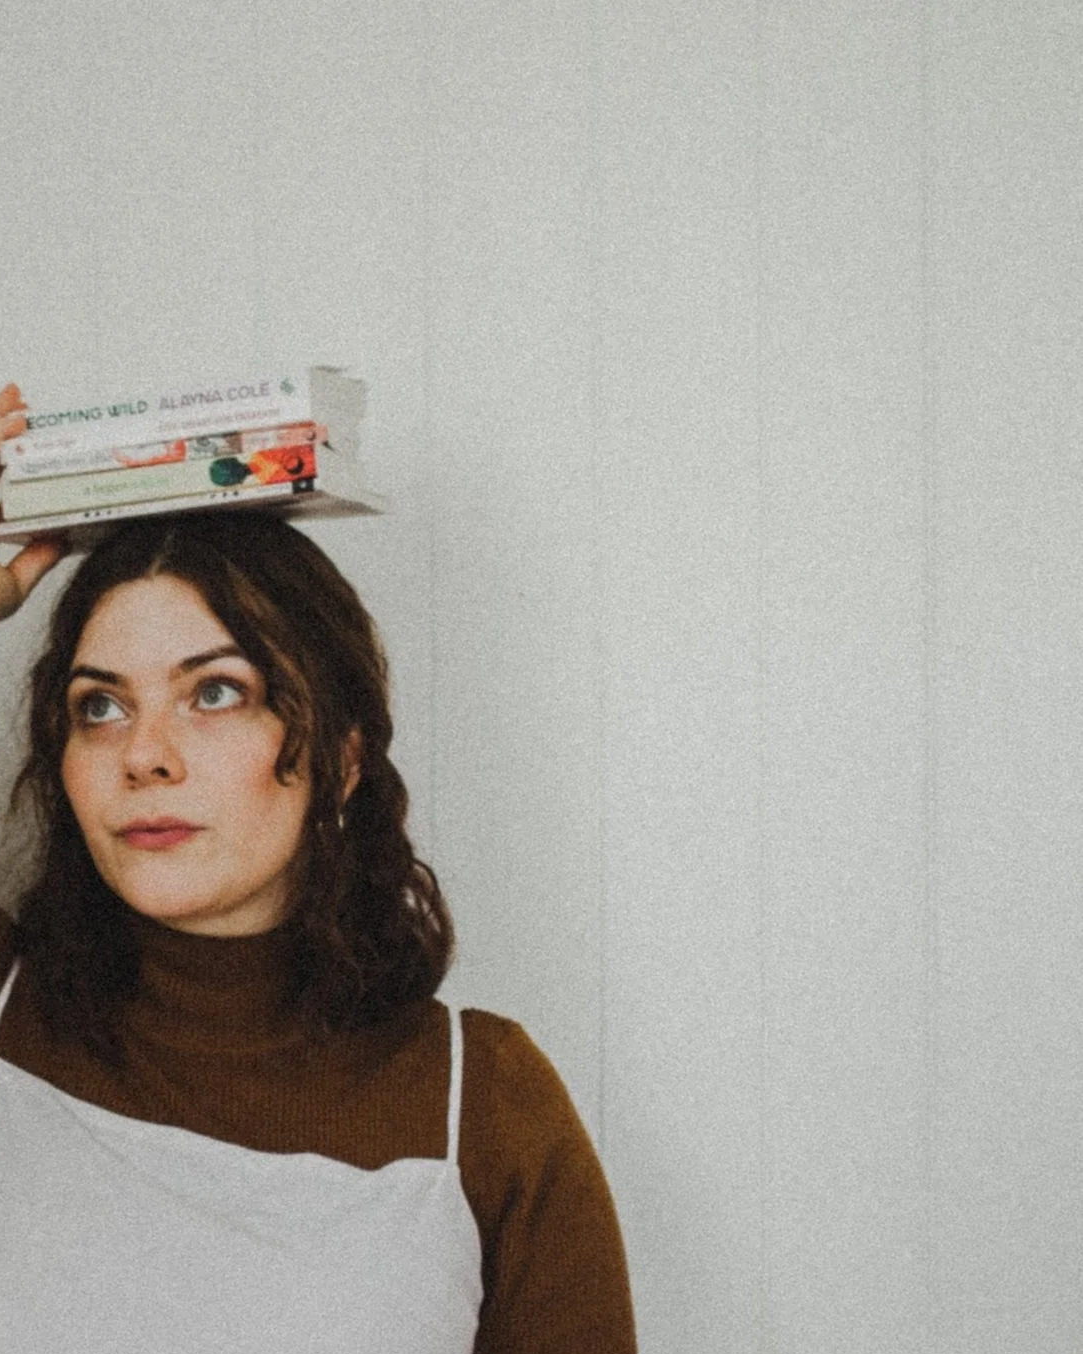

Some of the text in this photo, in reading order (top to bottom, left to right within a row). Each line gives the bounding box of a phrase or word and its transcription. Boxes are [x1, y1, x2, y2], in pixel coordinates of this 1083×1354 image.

[25, 381, 271, 430] ECOMING WILD ALAYNA COLE
